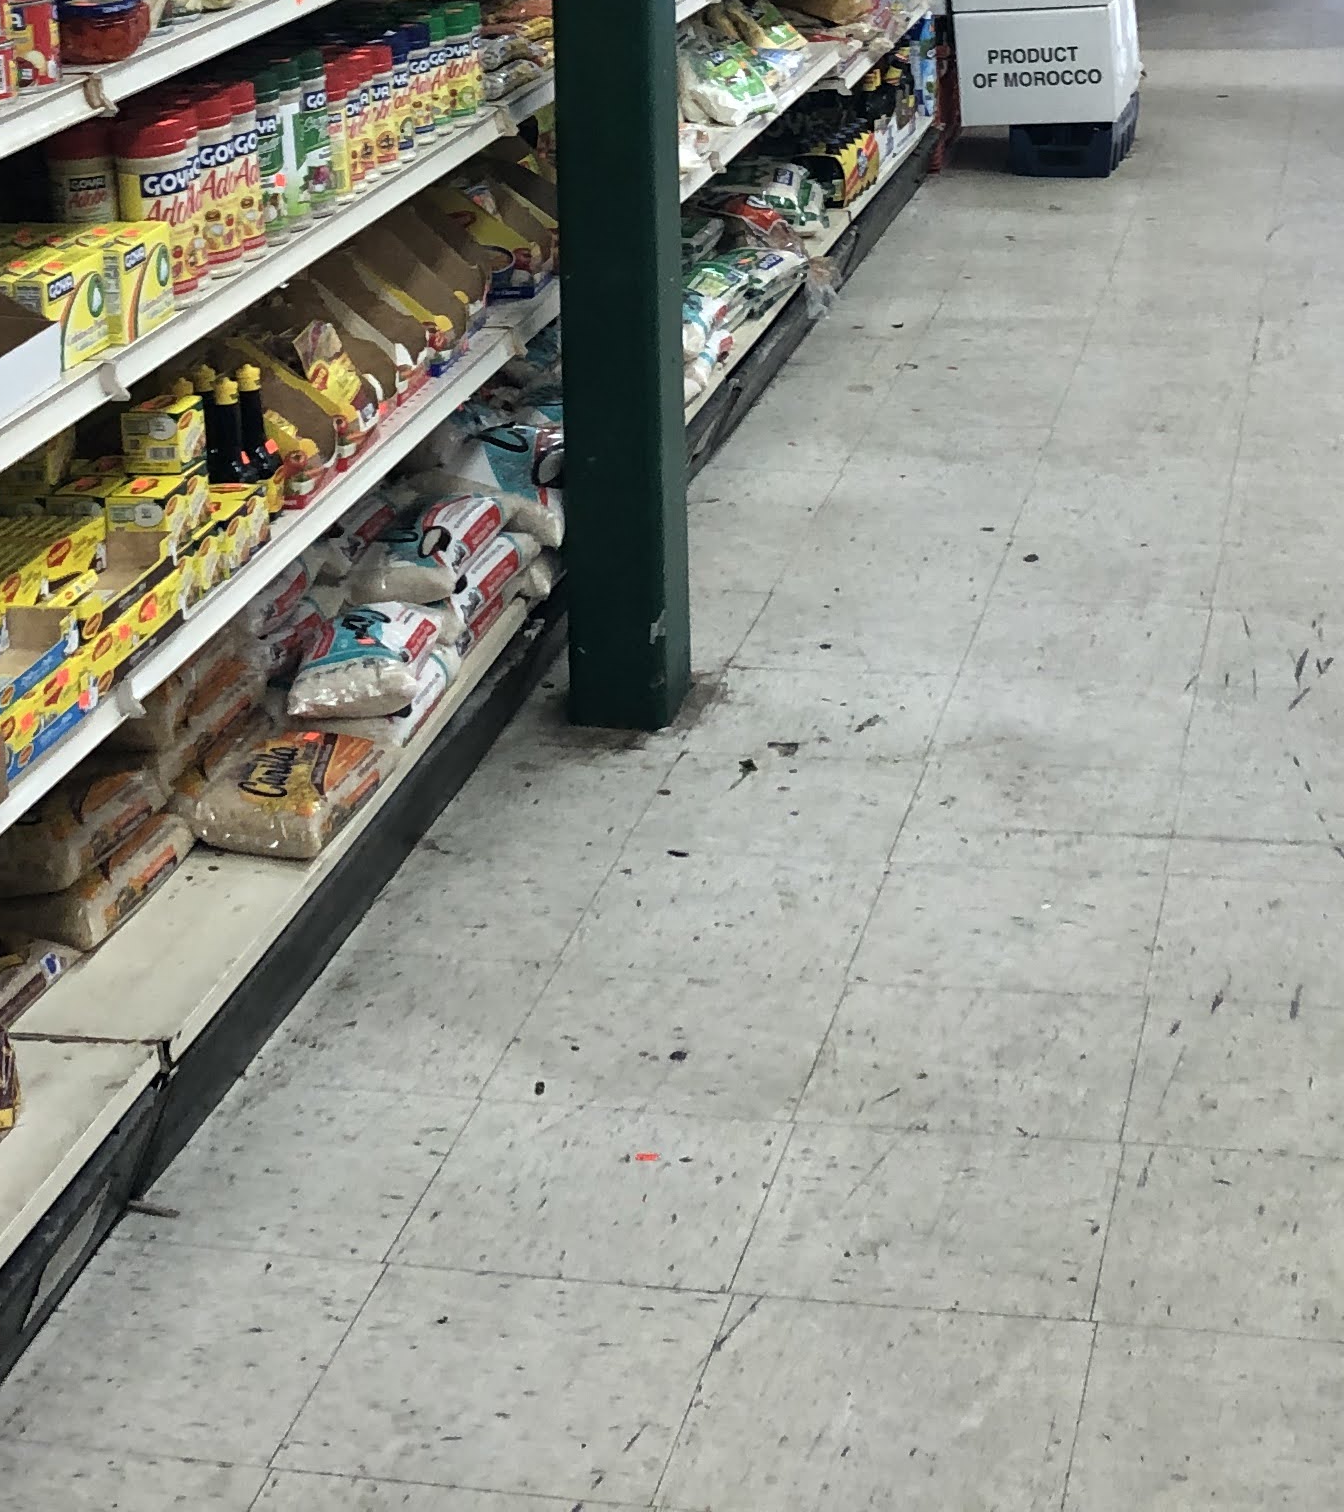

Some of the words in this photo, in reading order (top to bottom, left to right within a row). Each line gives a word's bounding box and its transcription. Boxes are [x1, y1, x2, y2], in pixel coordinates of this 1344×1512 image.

[988, 46, 1078, 65] PRODUCT
[973, 73, 998, 89] OF
[1003, 69, 1102, 87] MOROCCO
[307, 93, 325, 109] GO
[258, 118, 277, 135] YA
[235, 132, 257, 154] GO
[48, 274, 74, 299] GOYA
